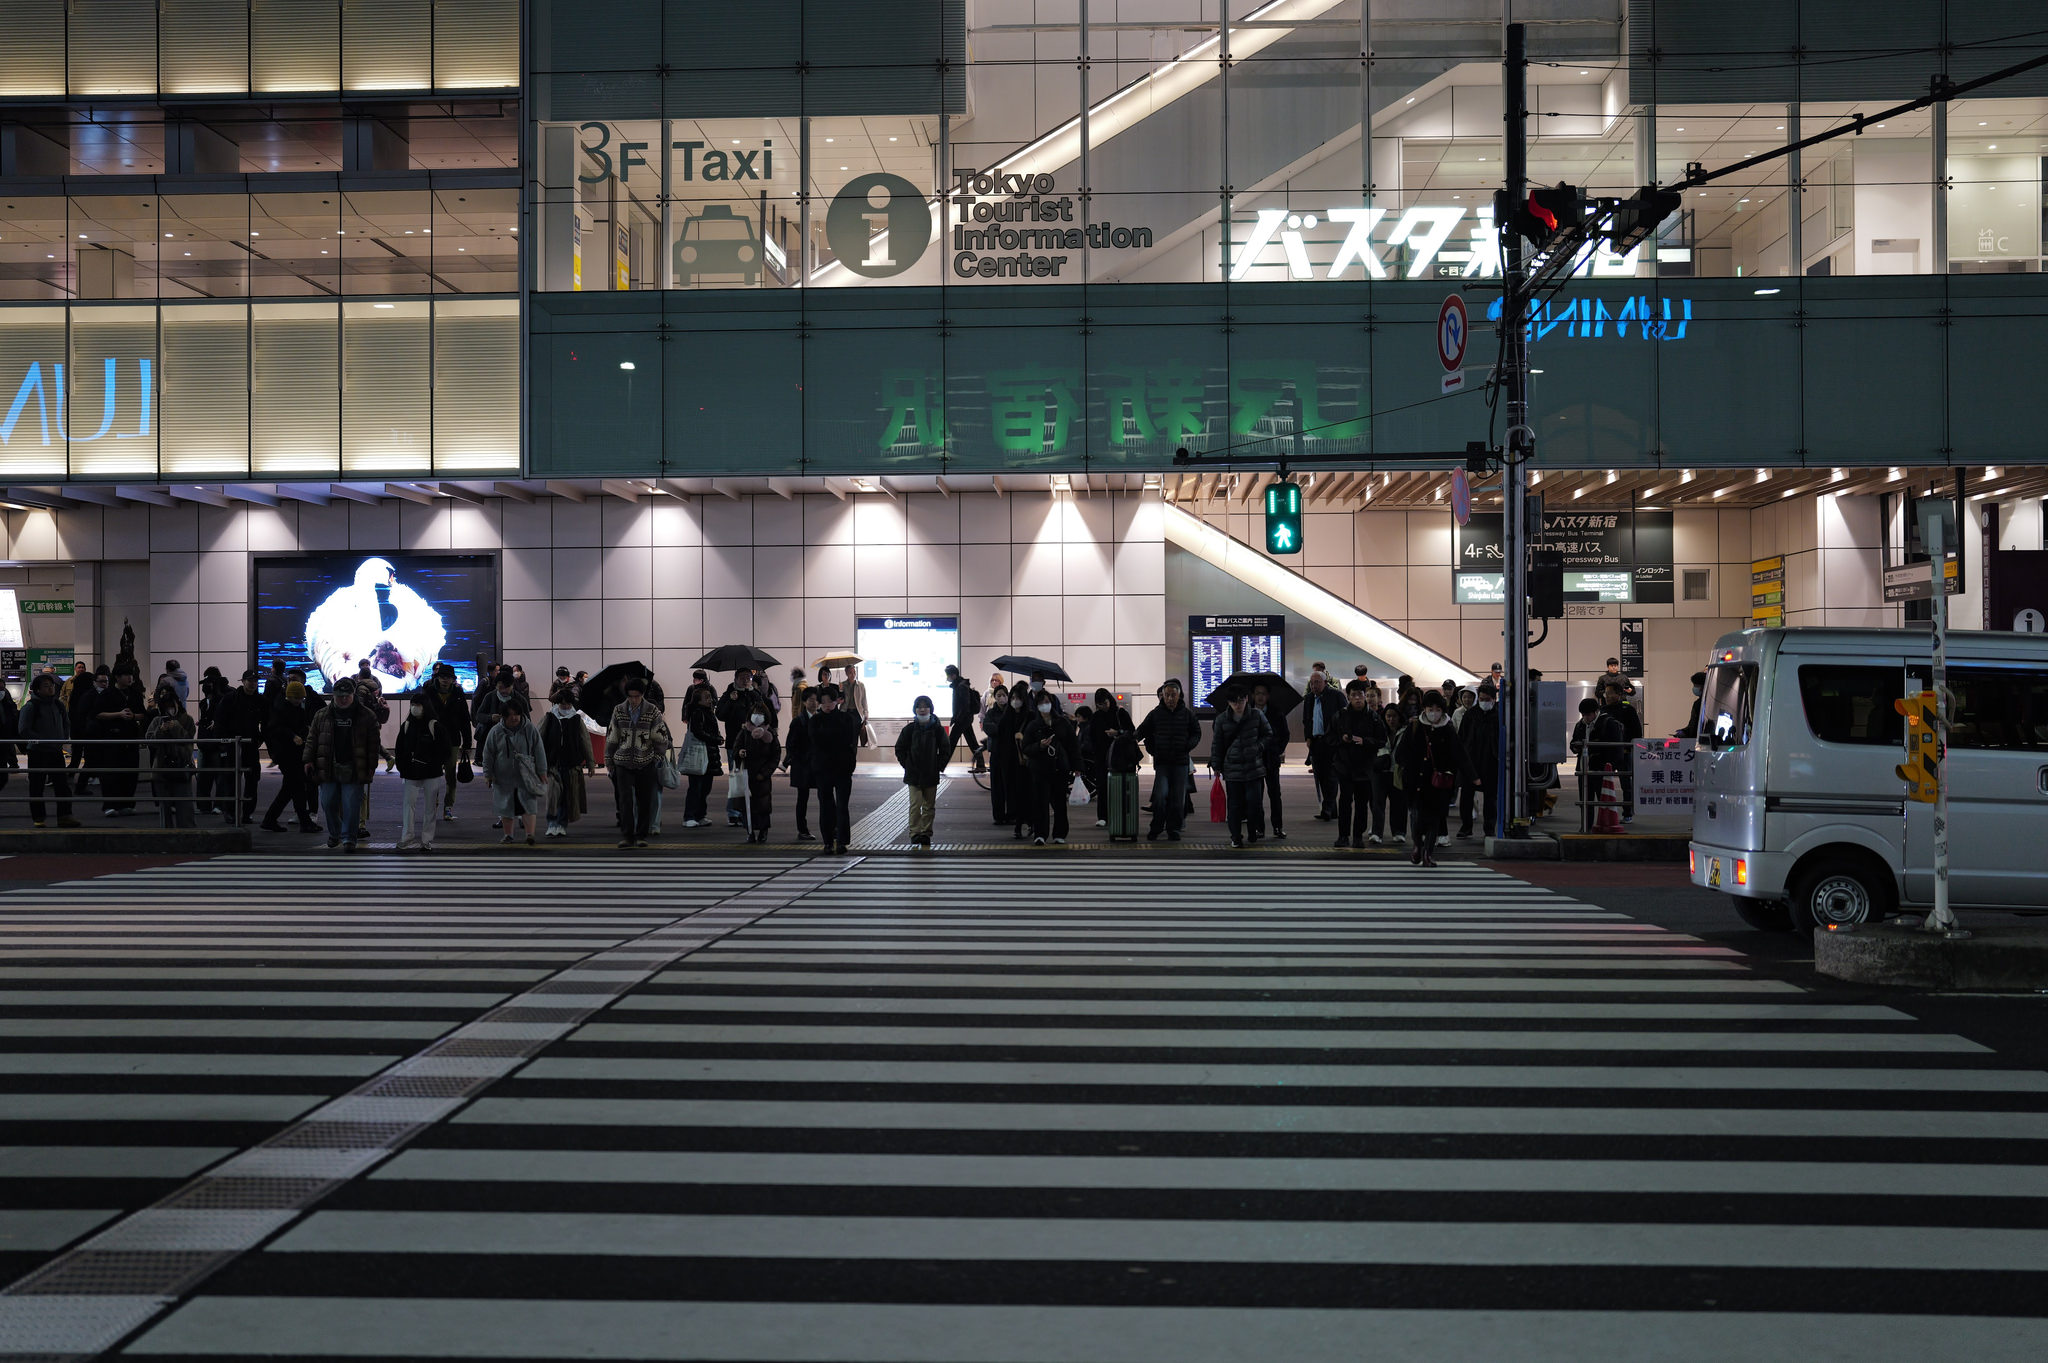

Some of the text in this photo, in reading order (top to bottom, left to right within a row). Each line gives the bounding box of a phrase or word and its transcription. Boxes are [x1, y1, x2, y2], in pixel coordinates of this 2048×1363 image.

[578, 122, 772, 184] 3F Taxi
[953, 168, 1055, 198] Tokyo
[953, 196, 1073, 222] Tourist
[954, 222, 1153, 250] Information
[953, 251, 1067, 278] Center
[1552, 515, 1618, 528] バスタ新宿
[1465, 544, 1483, 558] 4F
[1562, 555, 1603, 565] xpressway
[1604, 555, 1619, 563] Bus
[894, 619, 931, 628] Information
